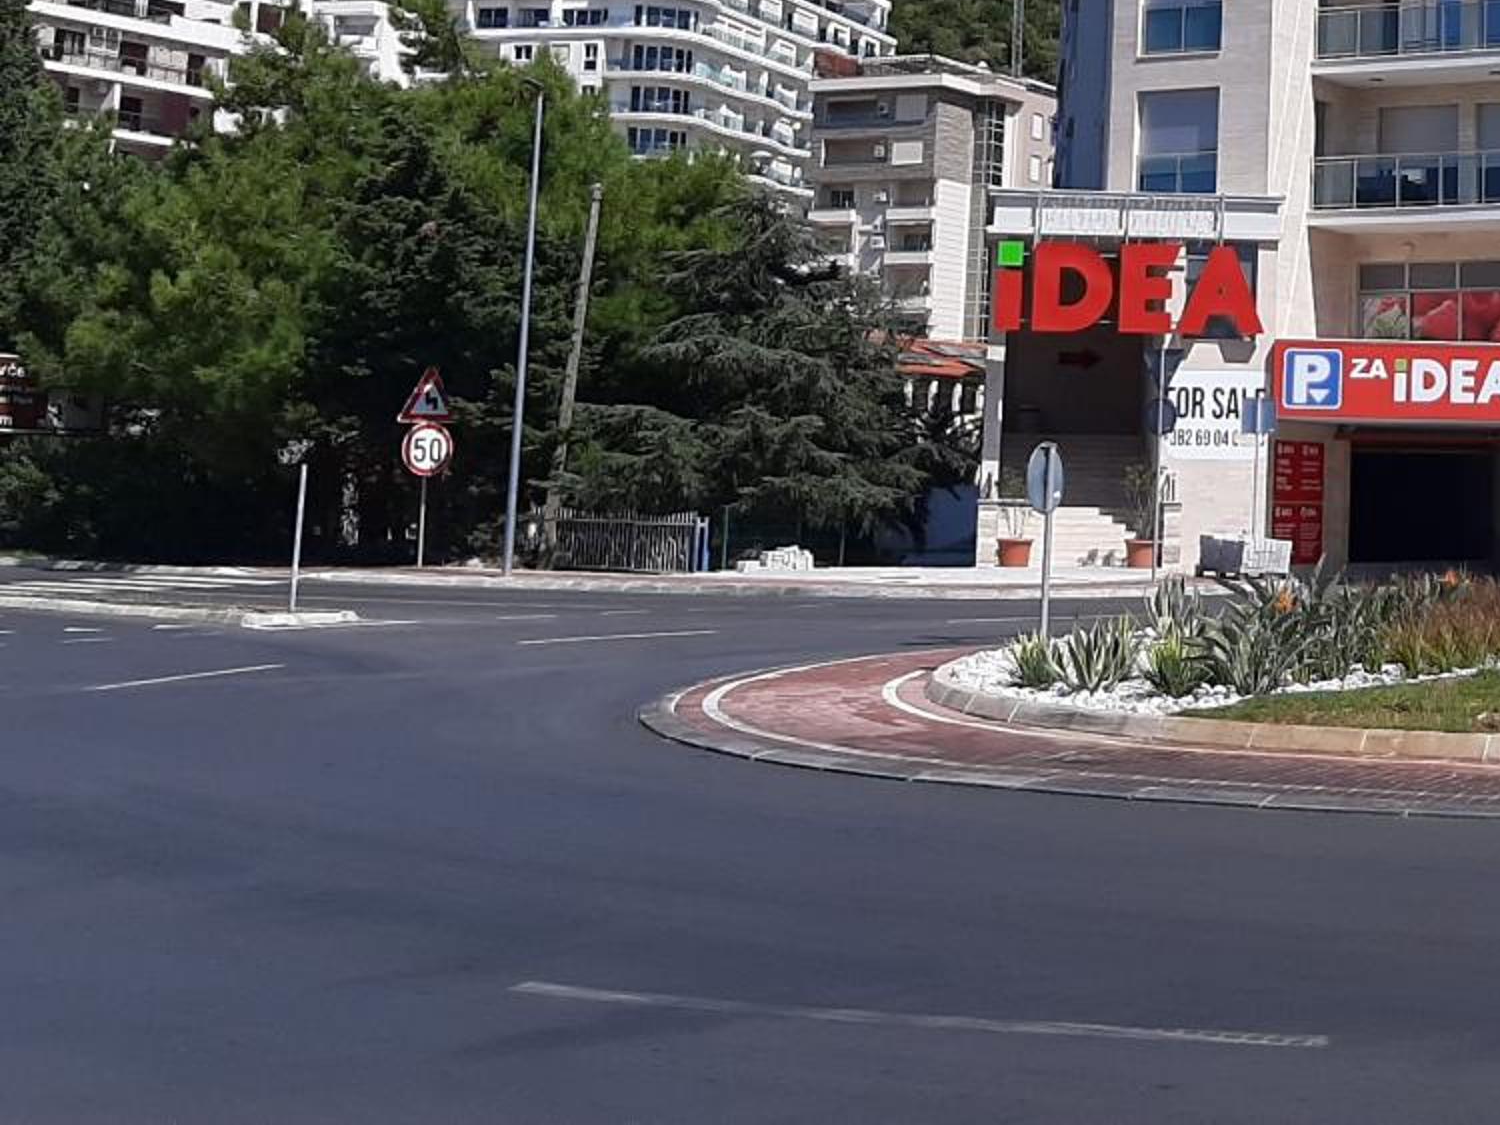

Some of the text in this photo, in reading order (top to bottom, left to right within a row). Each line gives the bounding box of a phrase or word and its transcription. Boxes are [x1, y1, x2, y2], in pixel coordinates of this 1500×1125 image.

[993, 240, 1264, 334] iDEA
[1292, 354, 1331, 404] P
[1349, 358, 1388, 380] ZA
[413, 437, 442, 463] 50
